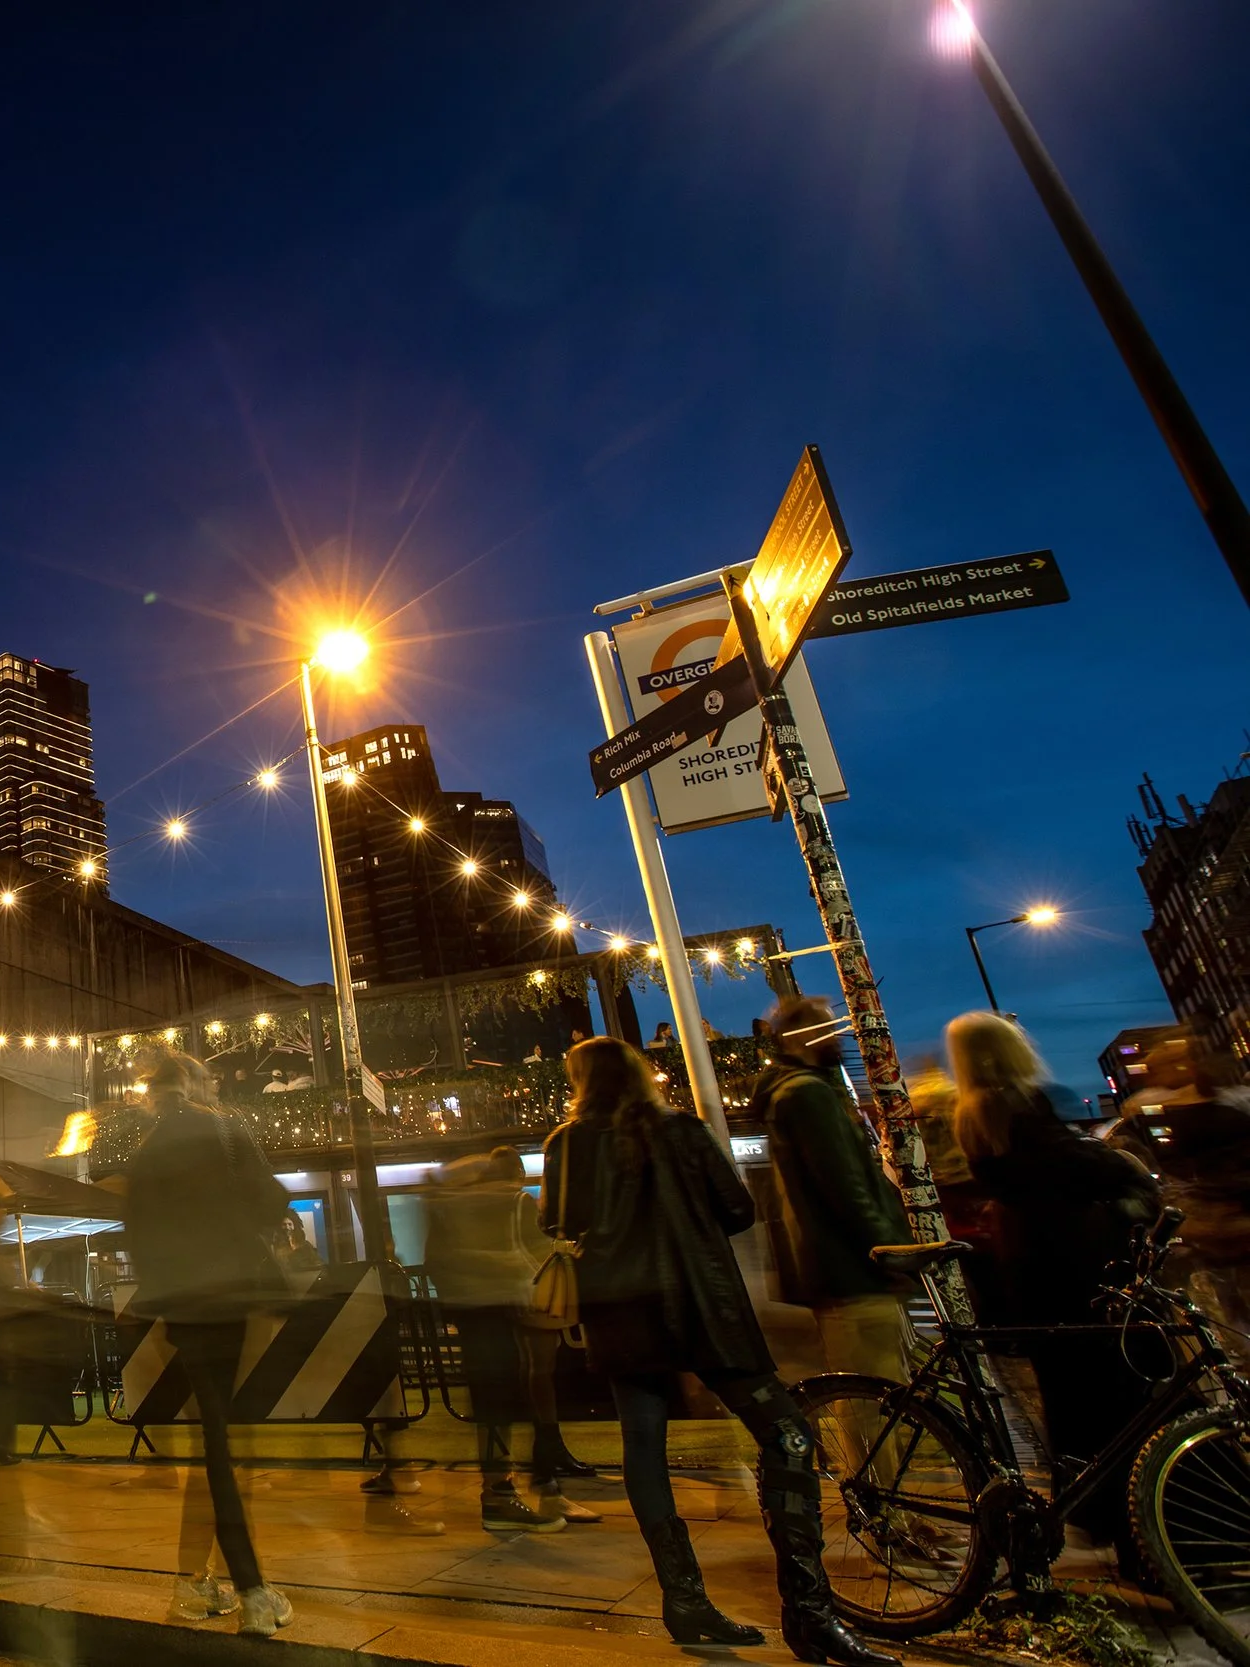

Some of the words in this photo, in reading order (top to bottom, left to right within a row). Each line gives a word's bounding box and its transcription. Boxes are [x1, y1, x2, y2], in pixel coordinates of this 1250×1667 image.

[785, 472, 804, 517] STREET
[797, 499, 814, 535] Street
[803, 527, 821, 563] Street
[827, 578, 918, 602] Shoreditch
[921, 572, 962, 586] High
[966, 562, 1023, 580] Street
[831, 611, 863, 626] Old
[867, 594, 965, 622] Spitalfields
[968, 586, 1034, 606] Market
[650, 661, 716, 688] OVERG
[603, 741, 624, 759] Rich
[623, 730, 641, 746] Mix
[610, 750, 651, 779] Columbia
[652, 731, 677, 754] Road
[678, 741, 762, 770] SHOREDI
[682, 767, 728, 787] HIGH
[341, 1173, 352, 1182] 39
